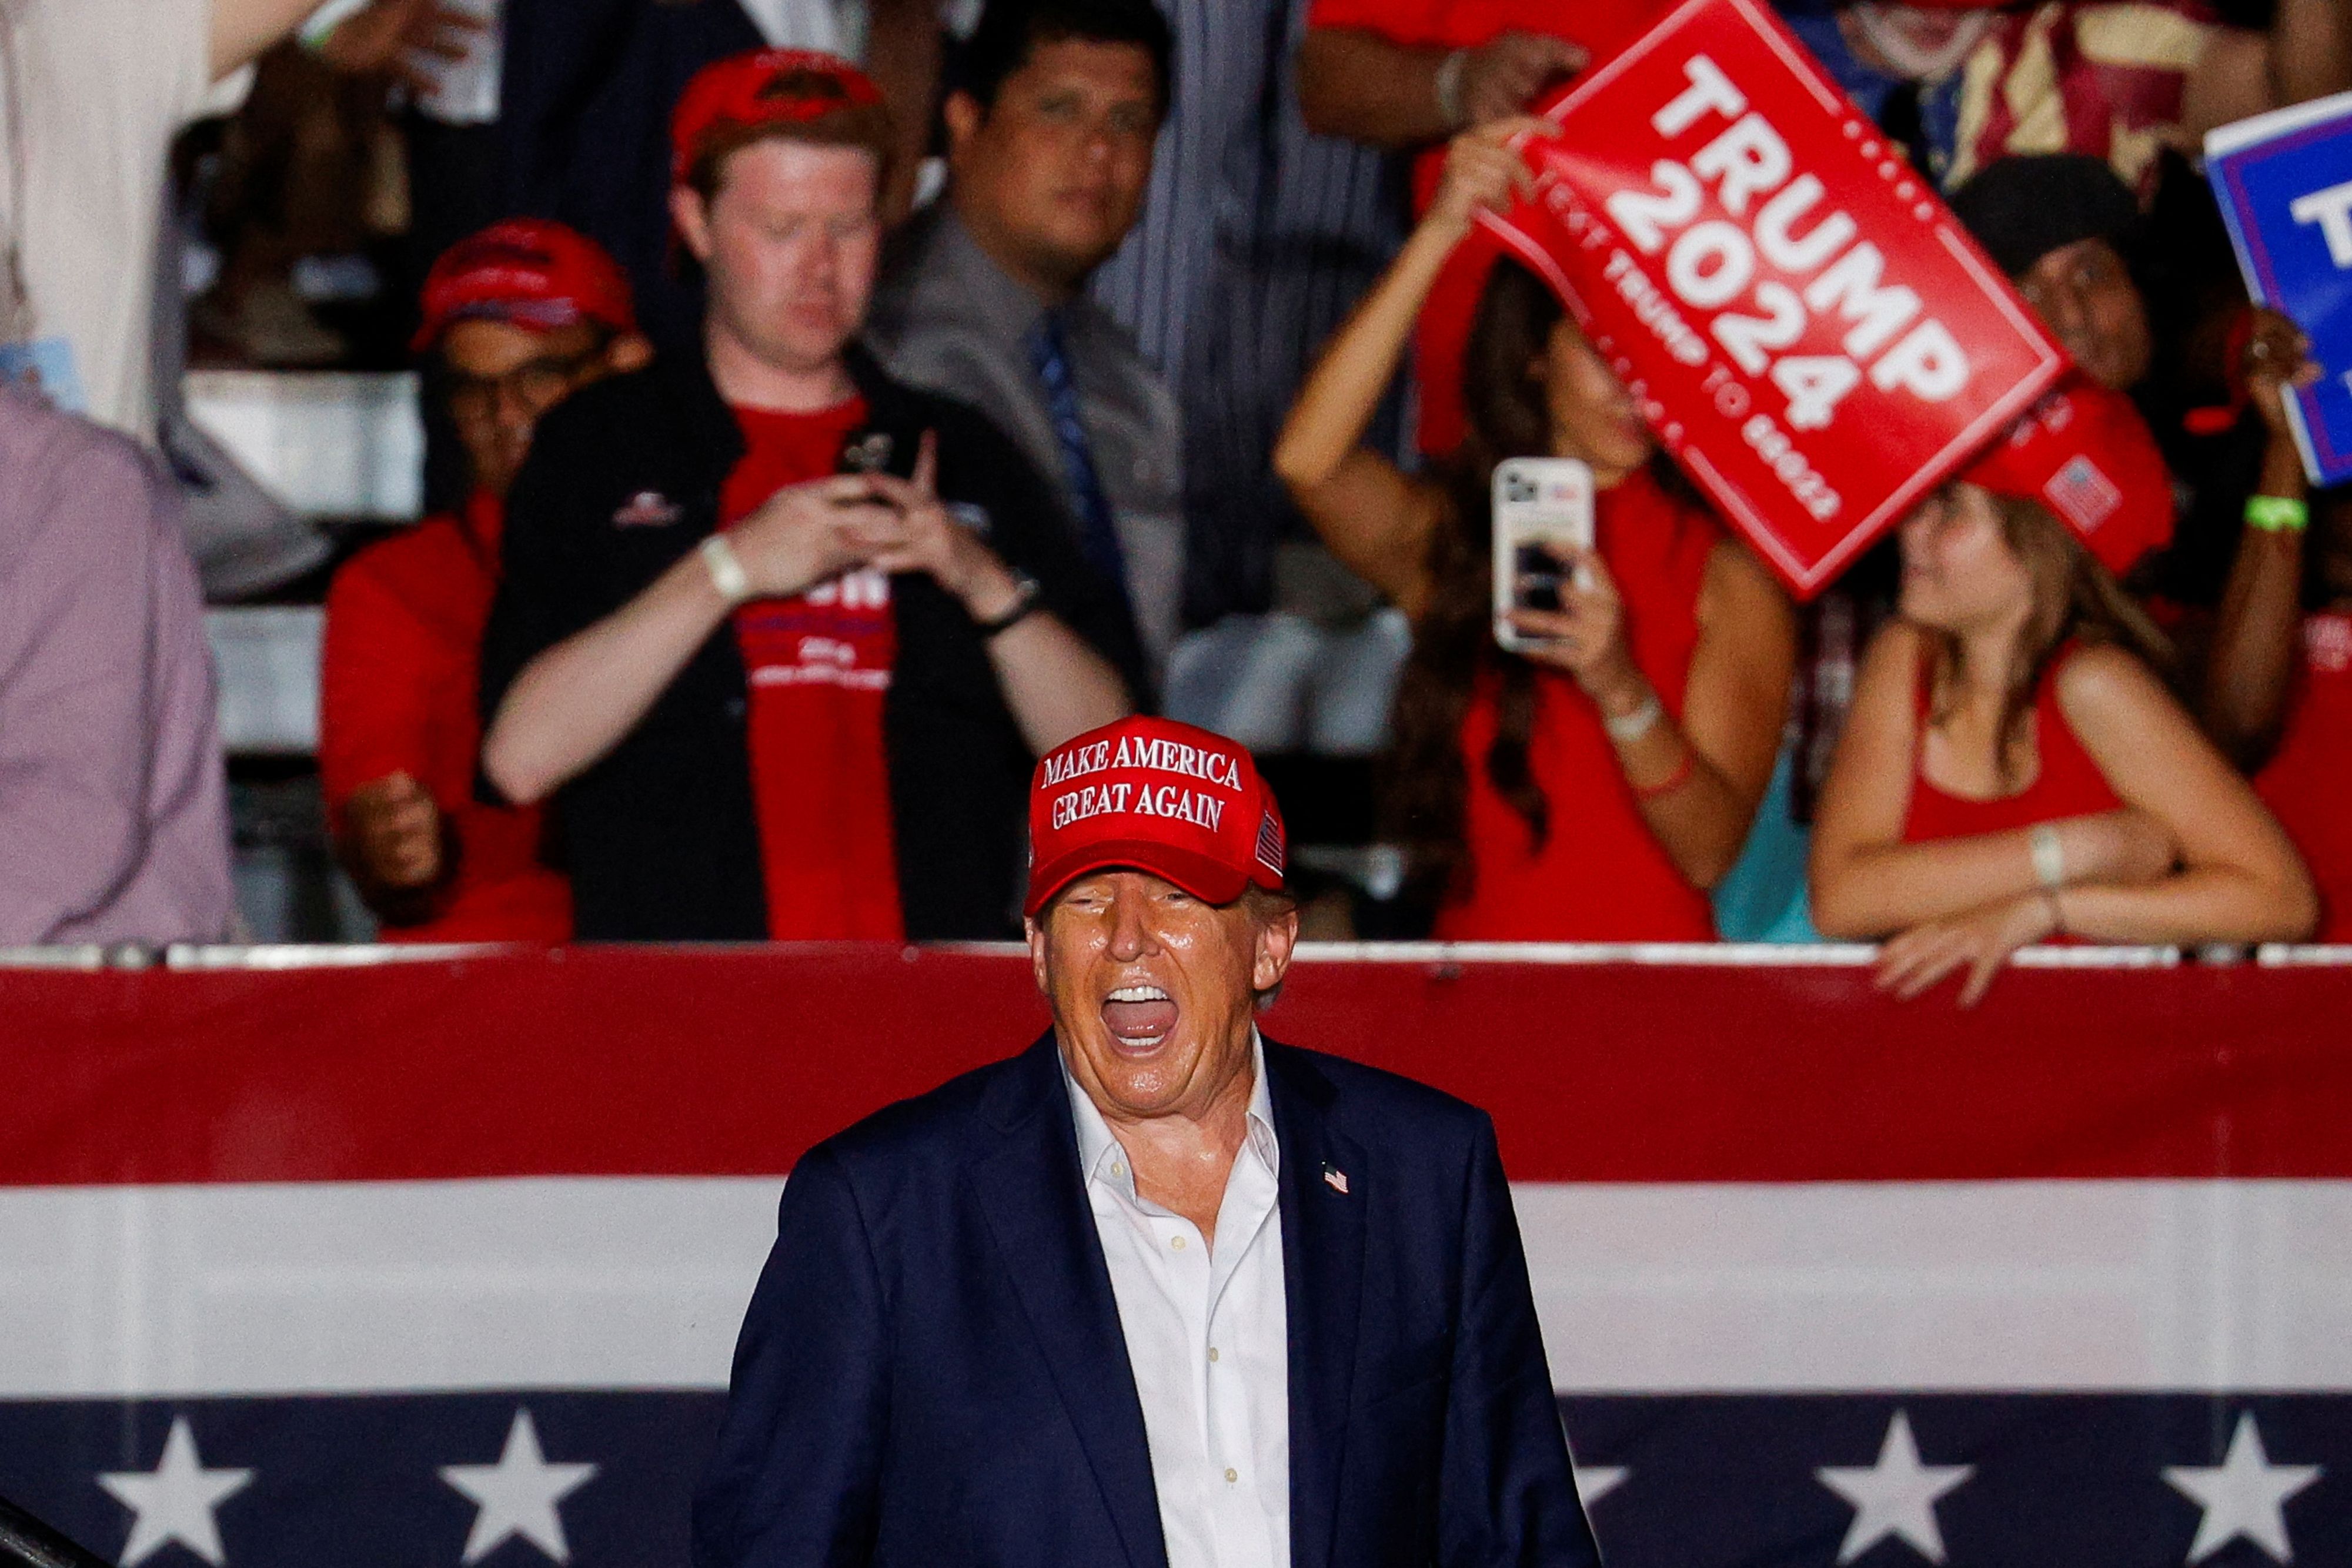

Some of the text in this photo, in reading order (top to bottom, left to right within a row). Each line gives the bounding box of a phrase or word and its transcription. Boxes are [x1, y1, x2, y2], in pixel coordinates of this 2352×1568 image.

[1606, 158, 1862, 432] 2024
[1651, 53, 1970, 402] TRUMP
[1602, 246, 1709, 367] TRUMP
[1700, 361, 1752, 419] TO
[1041, 736, 1242, 791] MAKE AMERICA
[1052, 783, 1225, 833] GREAT AGAIN
